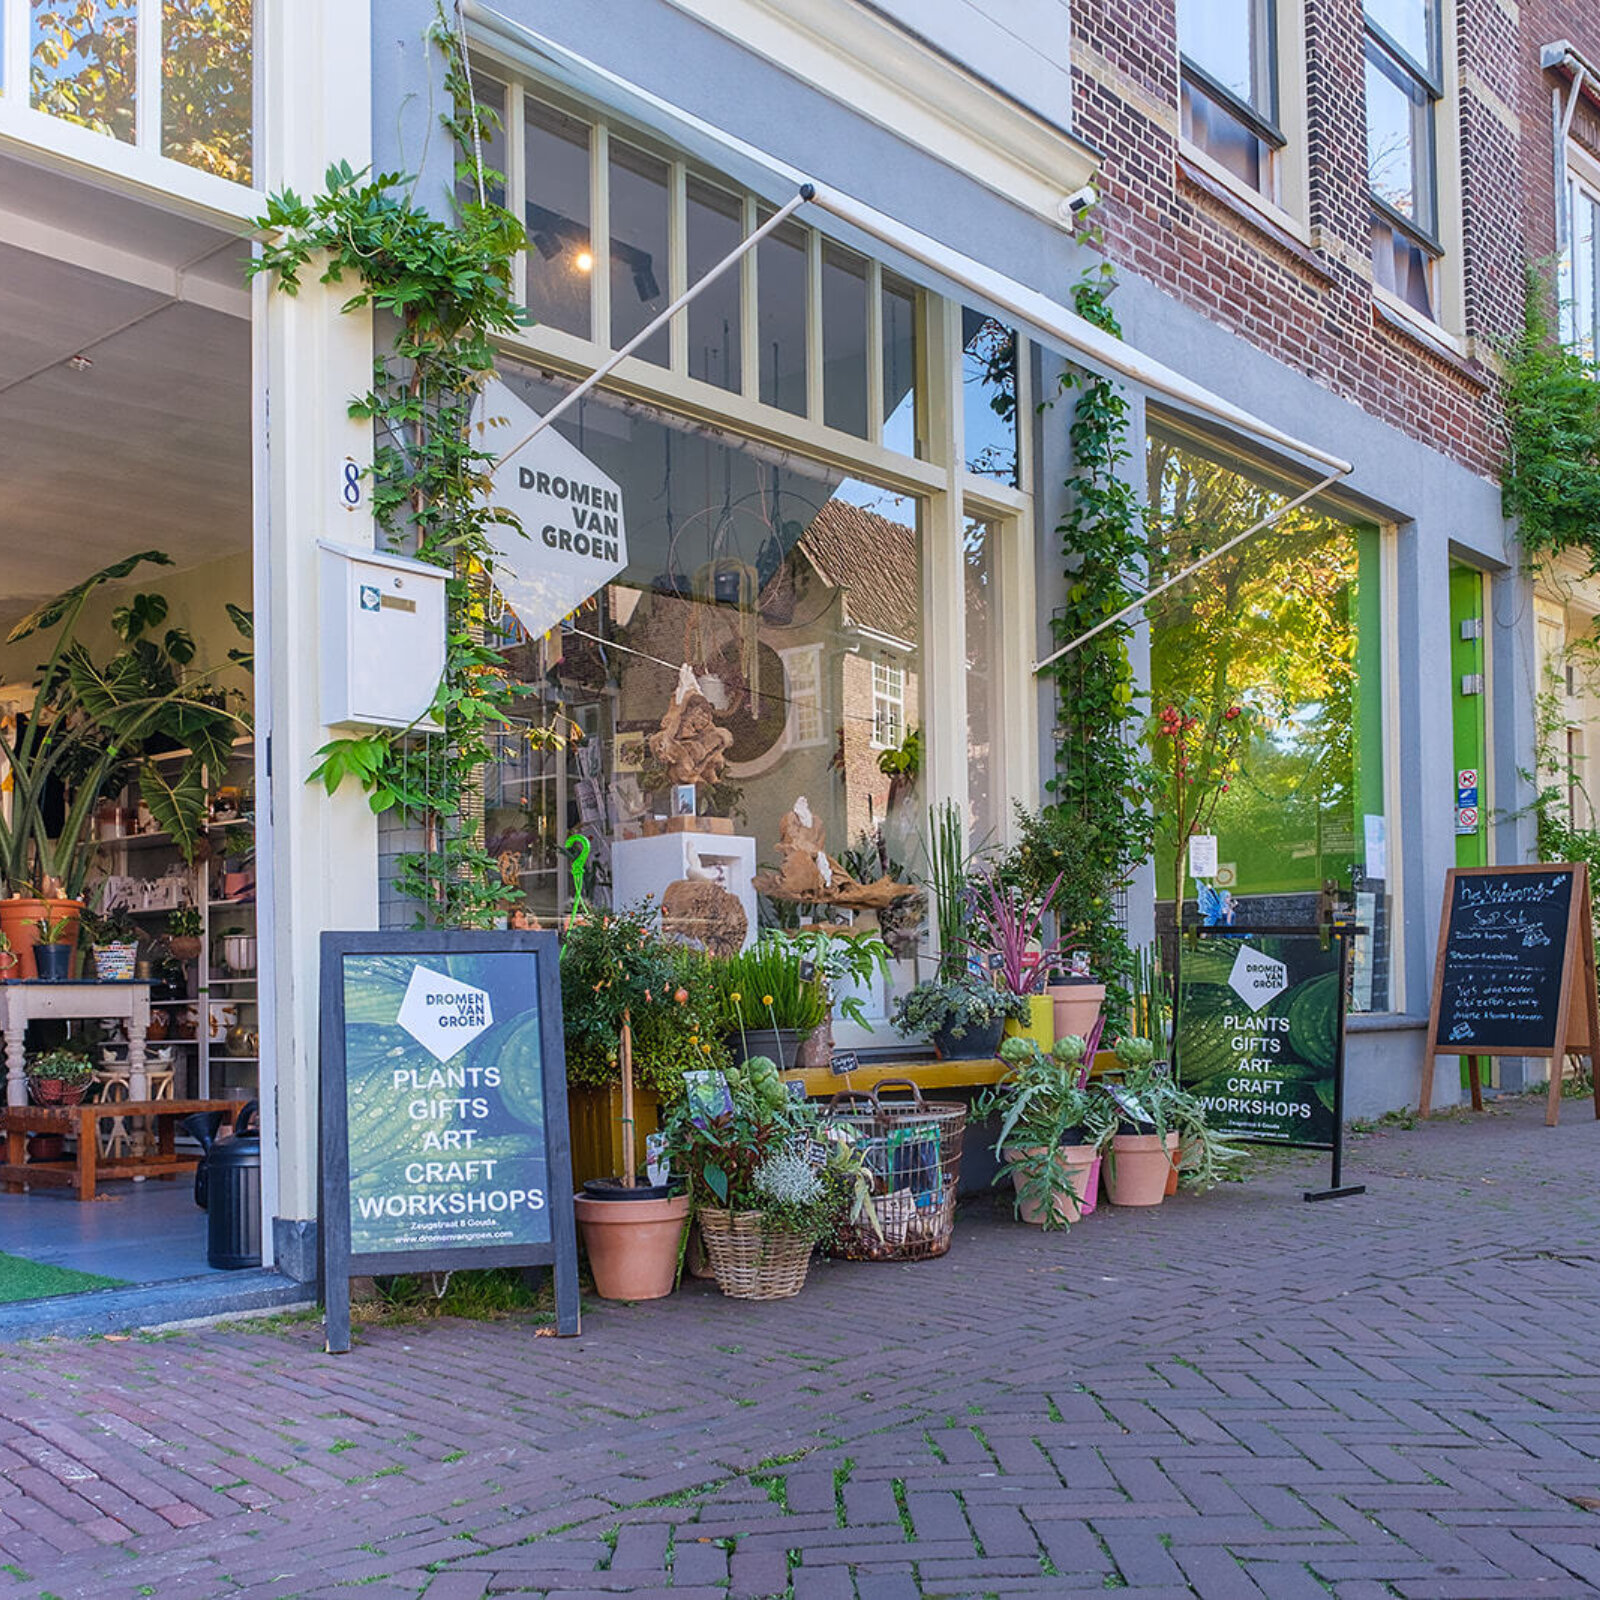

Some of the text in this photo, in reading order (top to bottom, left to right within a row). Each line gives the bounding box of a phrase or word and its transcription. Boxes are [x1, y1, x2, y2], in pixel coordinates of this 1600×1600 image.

[345, 463, 360, 504] 8
[519, 466, 618, 513] DROMEN
[572, 506, 618, 538] VAN
[541, 525, 619, 563] GROEN
[1246, 964, 1283, 973] DROMEN
[1265, 972, 1283, 980] VAN
[1253, 980, 1283, 988] GROEN
[426, 993, 484, 1005] DROMEN
[457, 1004, 484, 1015] VAN
[438, 1015, 485, 1027] GROEN
[1223, 1015, 1290, 1032] PLANTS
[1231, 1037, 1281, 1053] GIFTS
[1238, 1058, 1272, 1073] ART
[393, 1067, 501, 1090] PLANTS
[1227, 1078, 1284, 1095] CRAFT
[408, 1098, 489, 1120] GIFTS
[1201, 1097, 1312, 1118] WORKSHOPS
[423, 1129, 478, 1152] ART
[405, 1160, 497, 1184] CRAFT
[358, 1189, 544, 1218] WORKSHOPS
